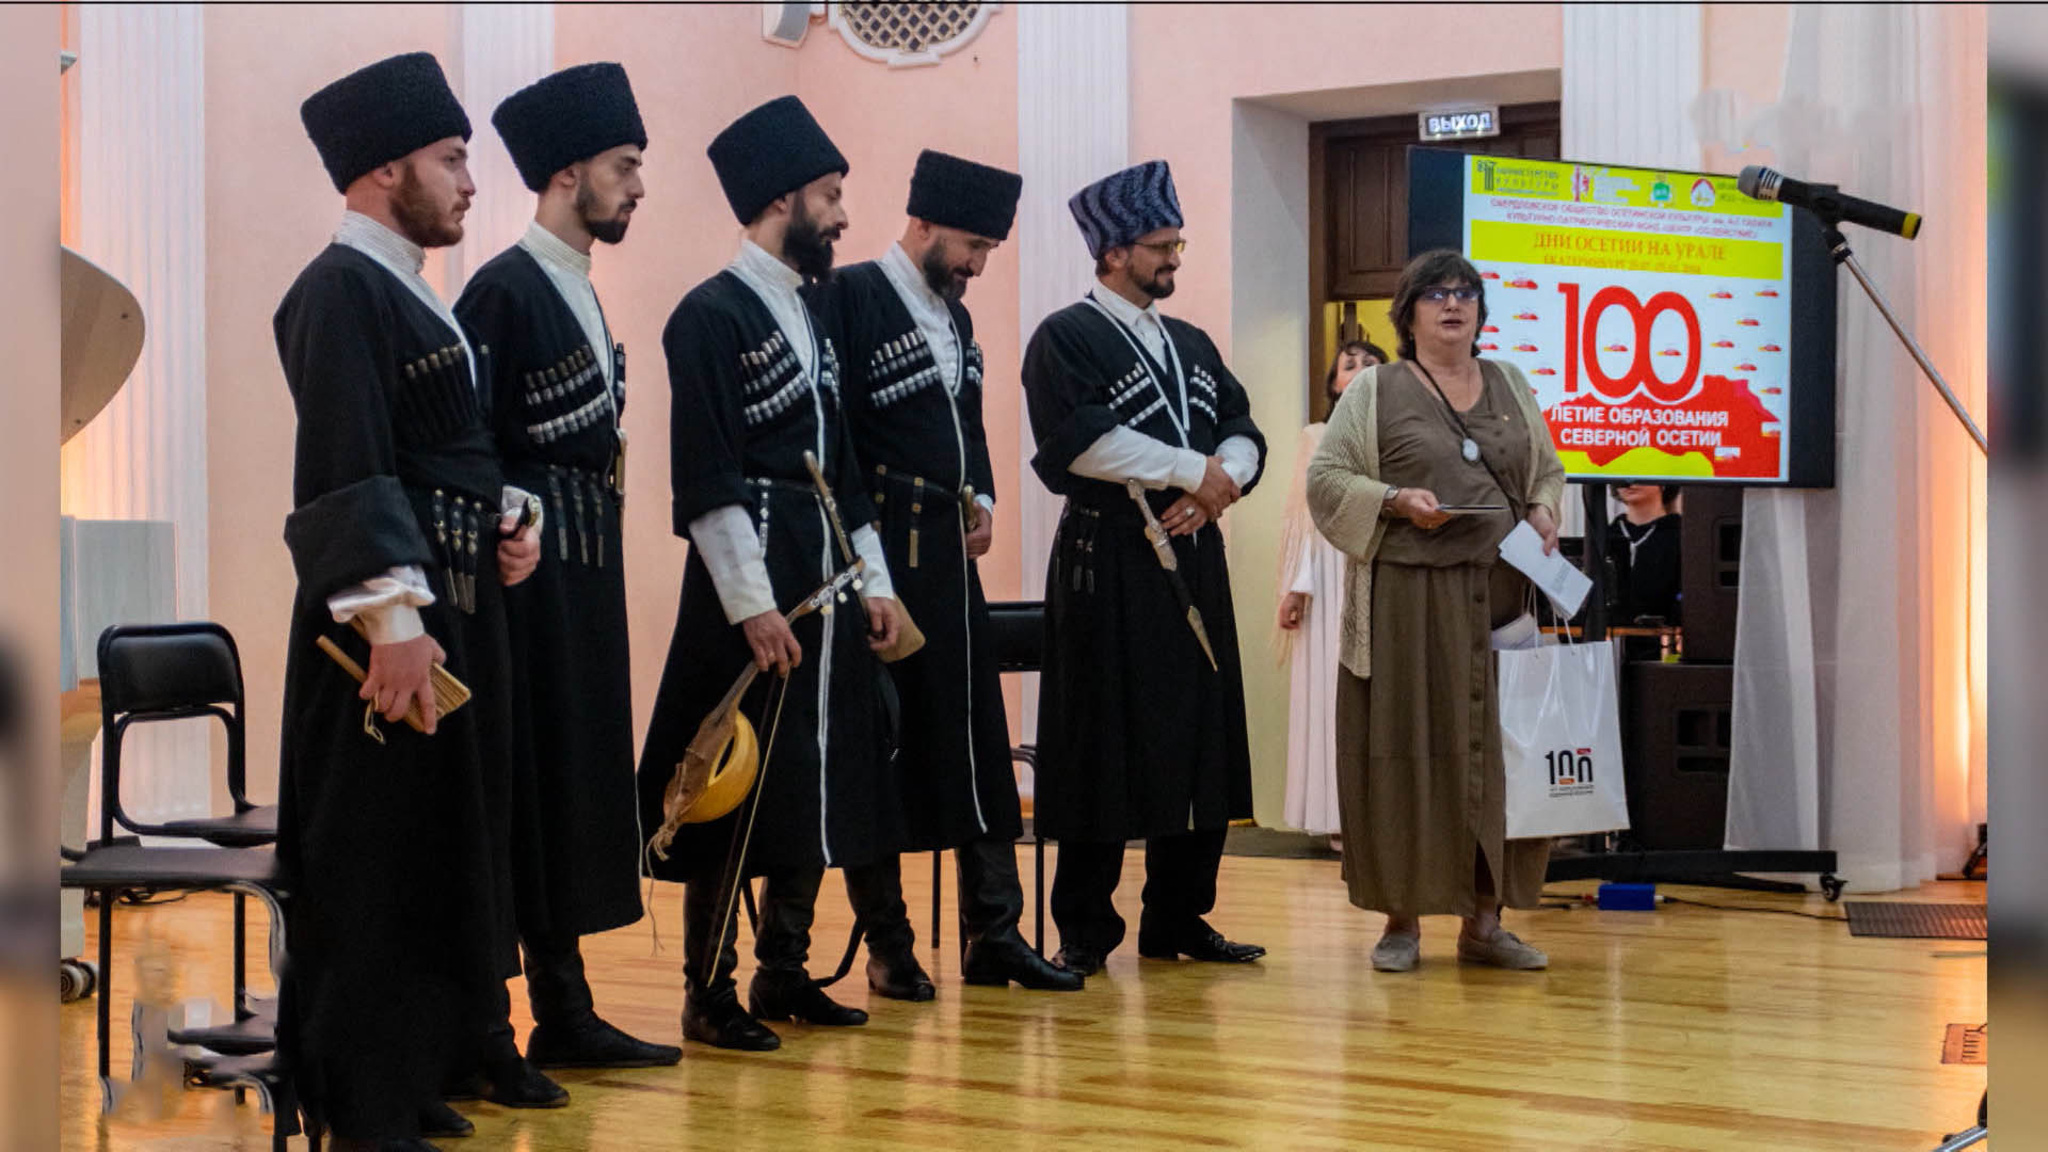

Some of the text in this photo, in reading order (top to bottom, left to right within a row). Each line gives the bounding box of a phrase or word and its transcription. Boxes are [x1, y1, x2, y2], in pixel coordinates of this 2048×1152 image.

[1428, 112, 1492, 133] ВЫХОД
[1533, 232, 1726, 260] ДНИ ОСЕТИИ НА УРАЛЕ
[1558, 282, 1702, 402] 100
[1551, 405, 1729, 427] ЛЕТИЕ ОБРАЗОВАНИЯ
[1560, 427, 1722, 447] СЕВЕРНОЙ ОСЕТИИ
